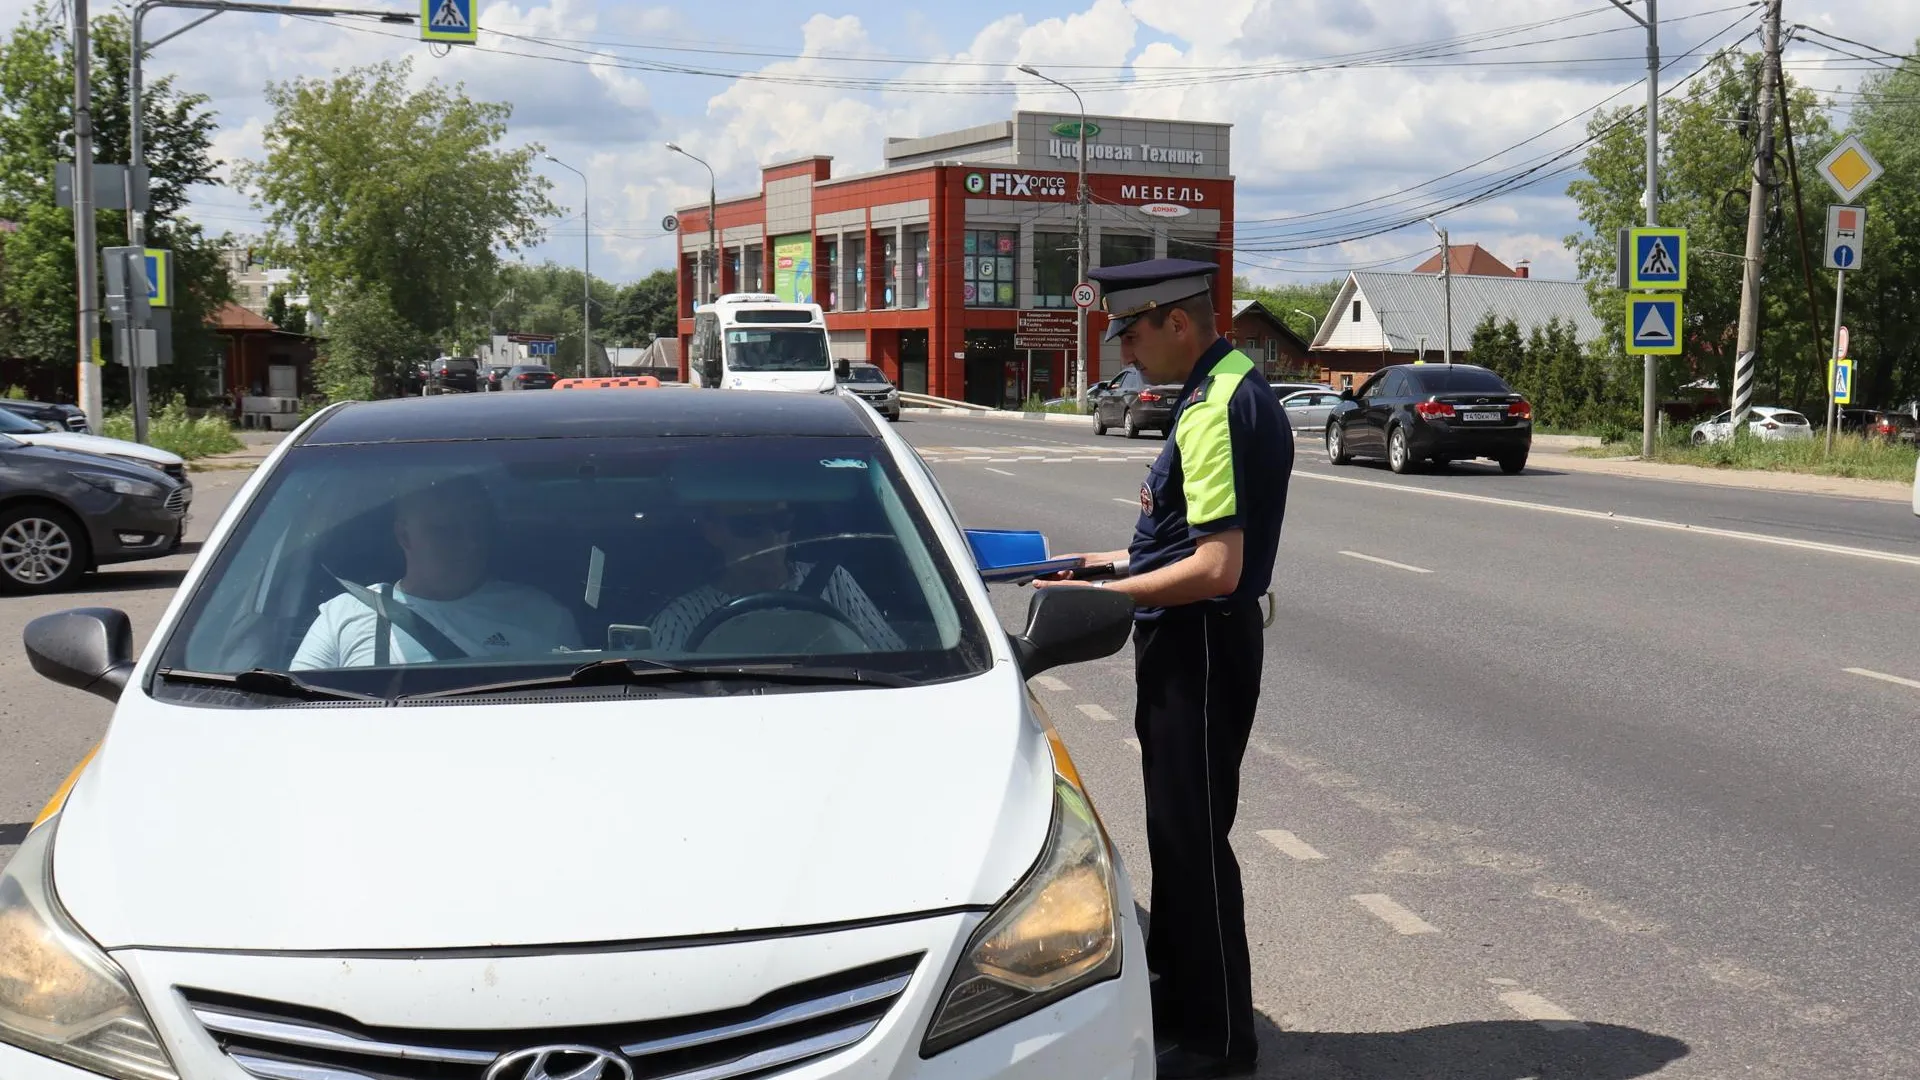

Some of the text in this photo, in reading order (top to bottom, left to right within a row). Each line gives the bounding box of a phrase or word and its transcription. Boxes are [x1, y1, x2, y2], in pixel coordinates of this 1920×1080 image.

[1140, 143, 1204, 164] Техника
[1121, 184, 1204, 202] МЕБЕЛЬ
[1078, 291, 1091, 301] 50
